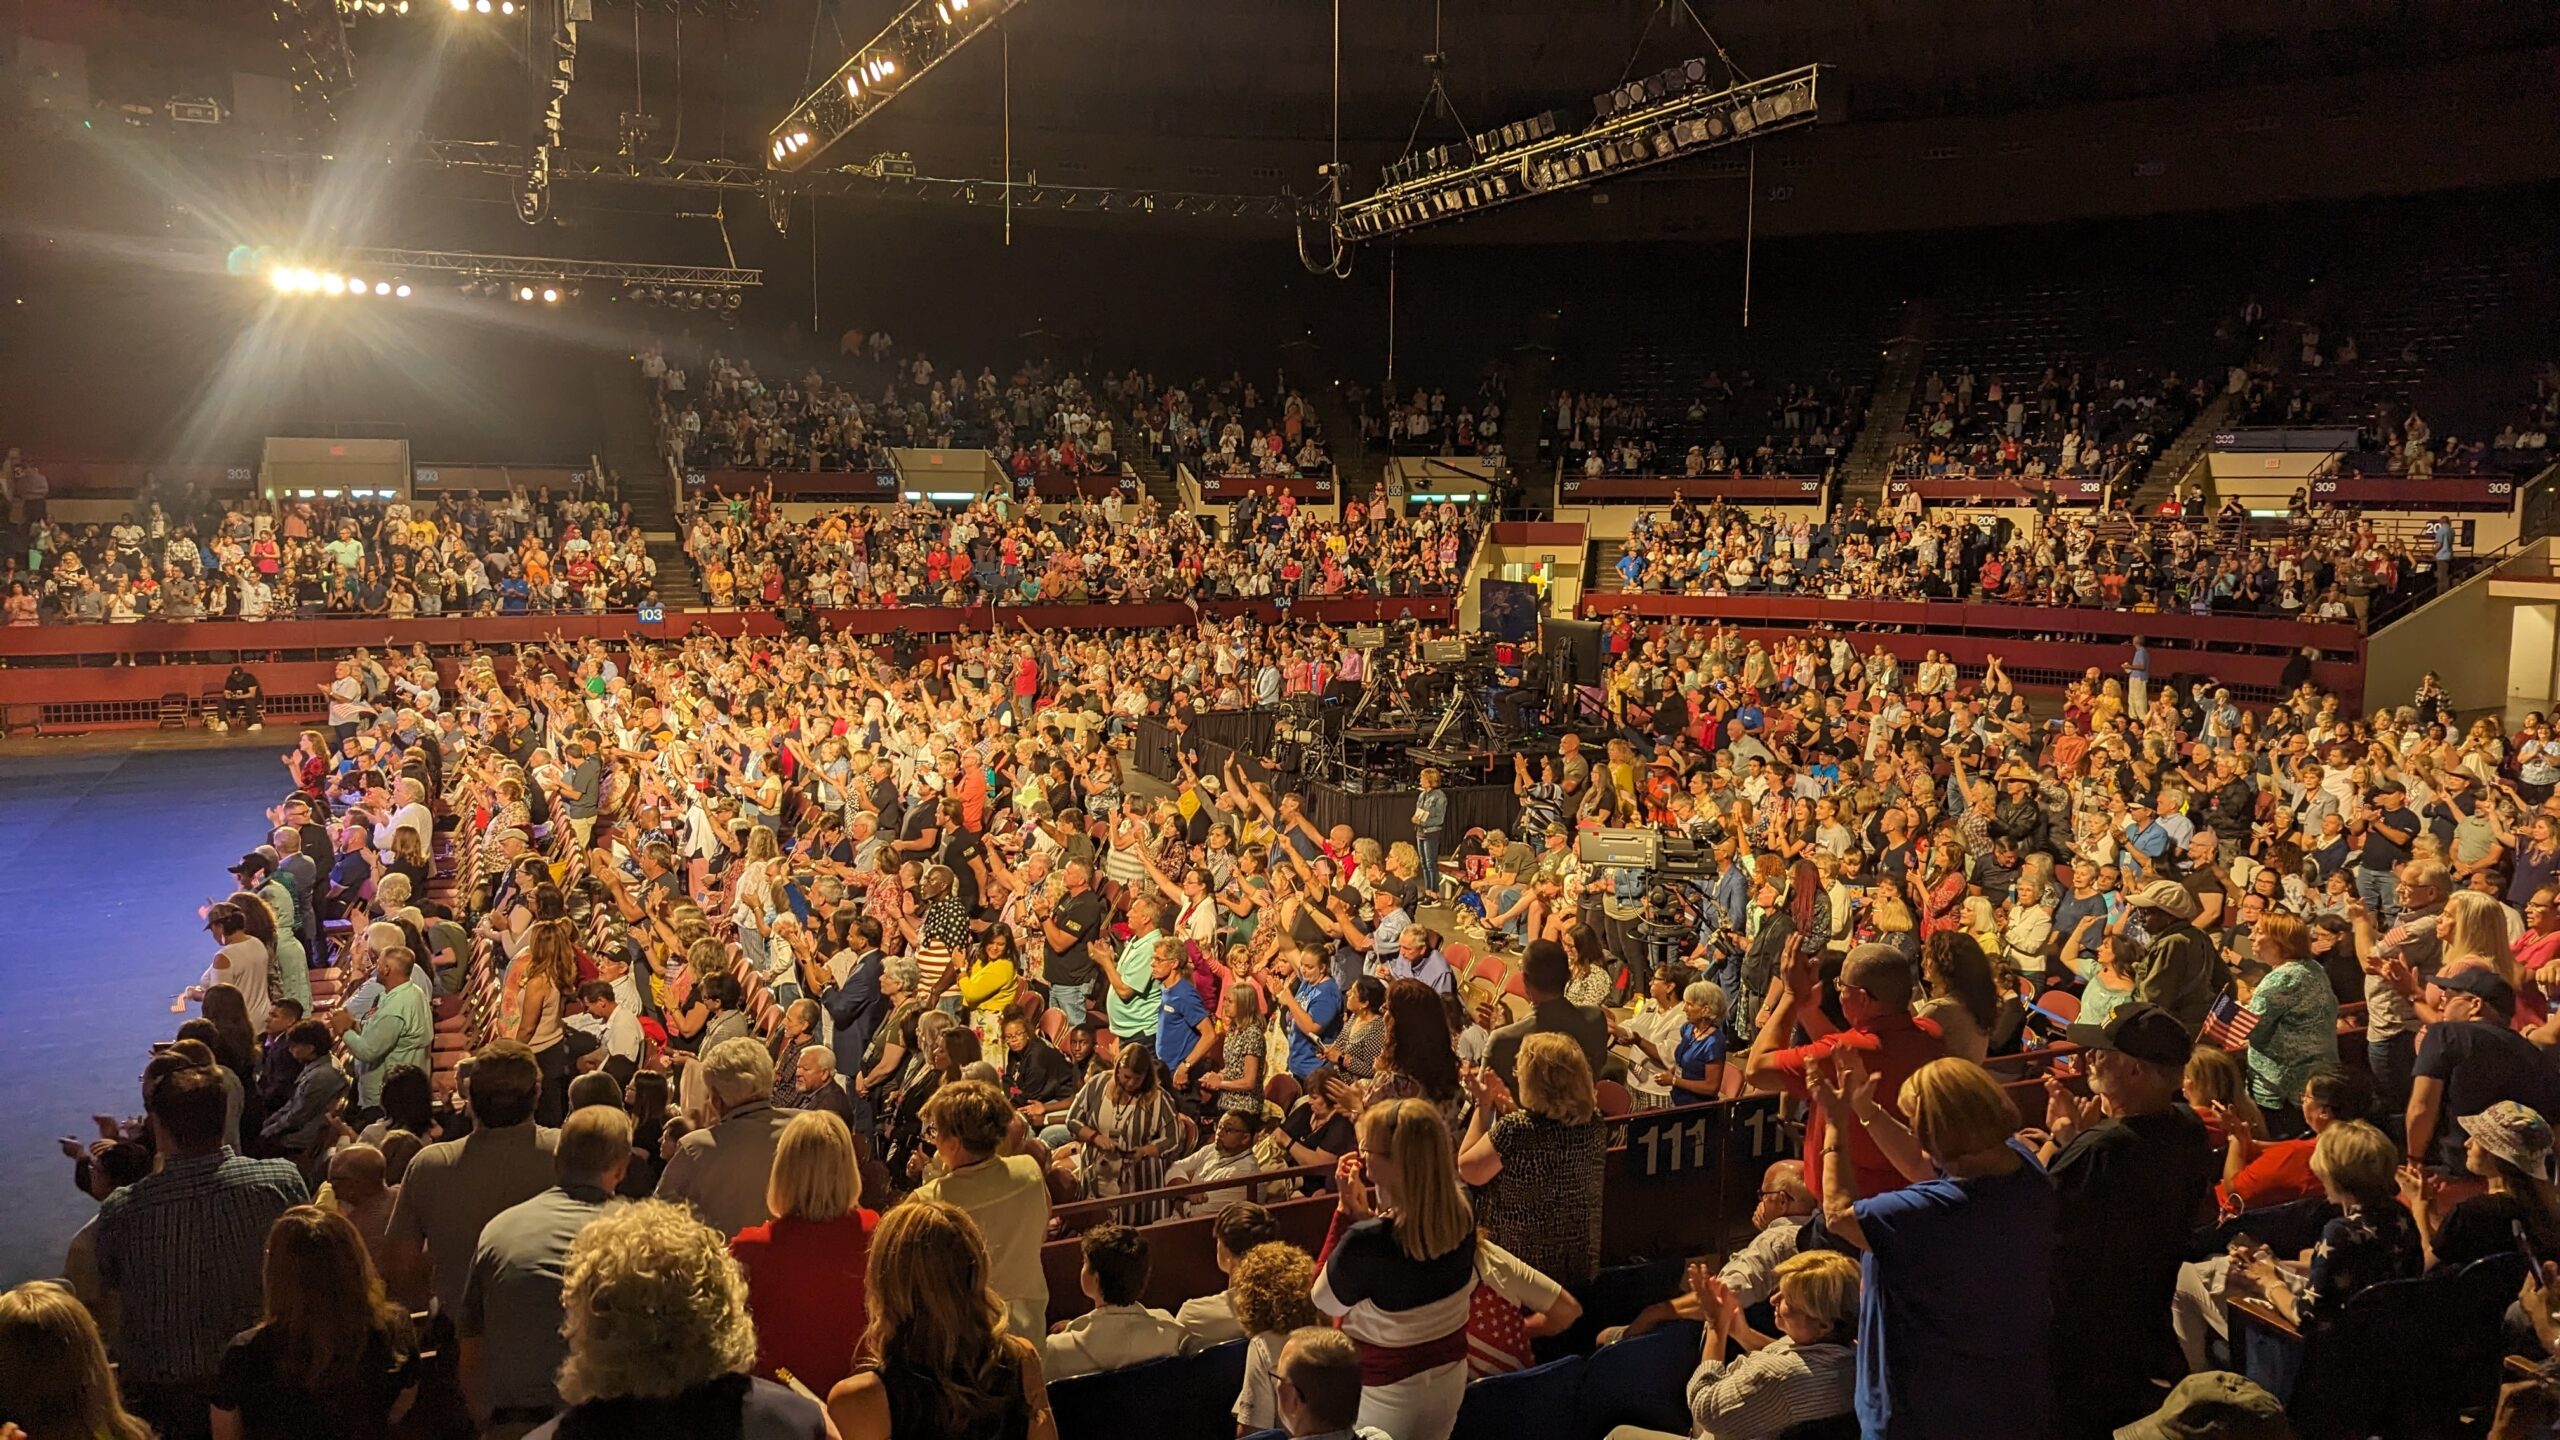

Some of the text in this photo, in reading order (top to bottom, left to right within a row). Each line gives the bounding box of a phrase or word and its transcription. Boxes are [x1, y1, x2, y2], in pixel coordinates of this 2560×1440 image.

[1482, 457, 1497, 467] 306
[227, 469, 251, 480] 303
[416, 470, 438, 481] 303
[571, 473, 585, 483] 30
[686, 474, 706, 485] 304
[876, 476, 894, 486] 304
[1017, 477, 1034, 487] 304
[1119, 479, 1136, 489] 304
[1204, 480, 1220, 489] 305
[1315, 481, 1331, 490] 305
[1563, 482, 1580, 491] 307
[1801, 482, 1818, 491] 307
[2080, 482, 2100, 492] 308
[2314, 482, 2336, 492] 309
[2488, 483, 2511, 494] 309
[1977, 515, 1997, 526] 206
[2426, 522, 2442, 534] 20
[1273, 597, 1291, 607] 104
[639, 609, 663, 620] 103
[1744, 1109, 1784, 1157] 11
[1638, 1118, 1706, 1176] 111
